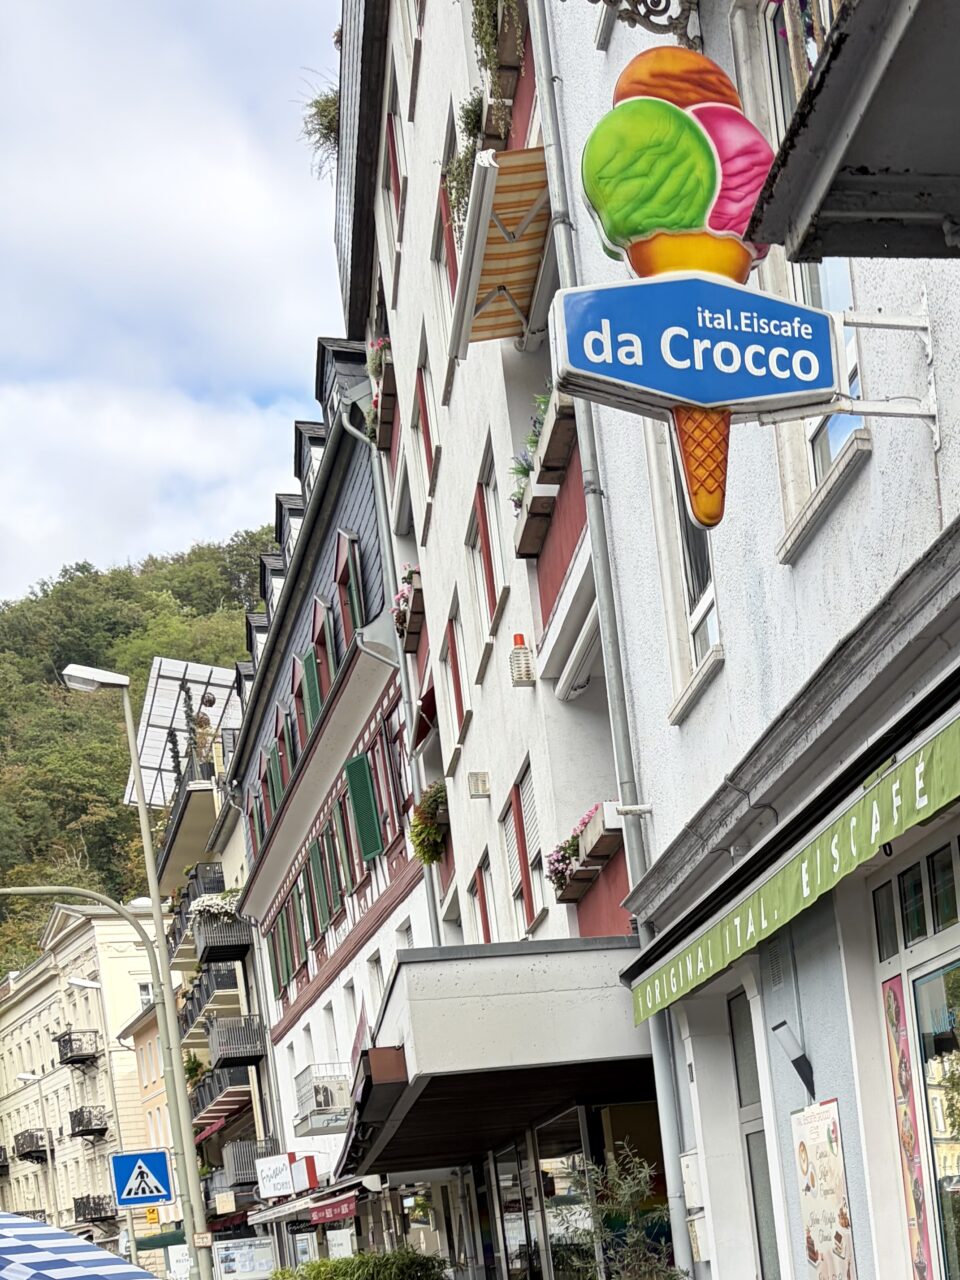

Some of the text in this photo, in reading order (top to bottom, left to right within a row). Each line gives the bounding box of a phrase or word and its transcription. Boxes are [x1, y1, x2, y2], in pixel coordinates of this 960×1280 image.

[583, 319, 819, 381] da Crocco
[697, 307, 813, 340] ital.Eiscafe
[646, 940, 713, 1009] ORIGINAL
[801, 750, 928, 898] EISCAFÉ
